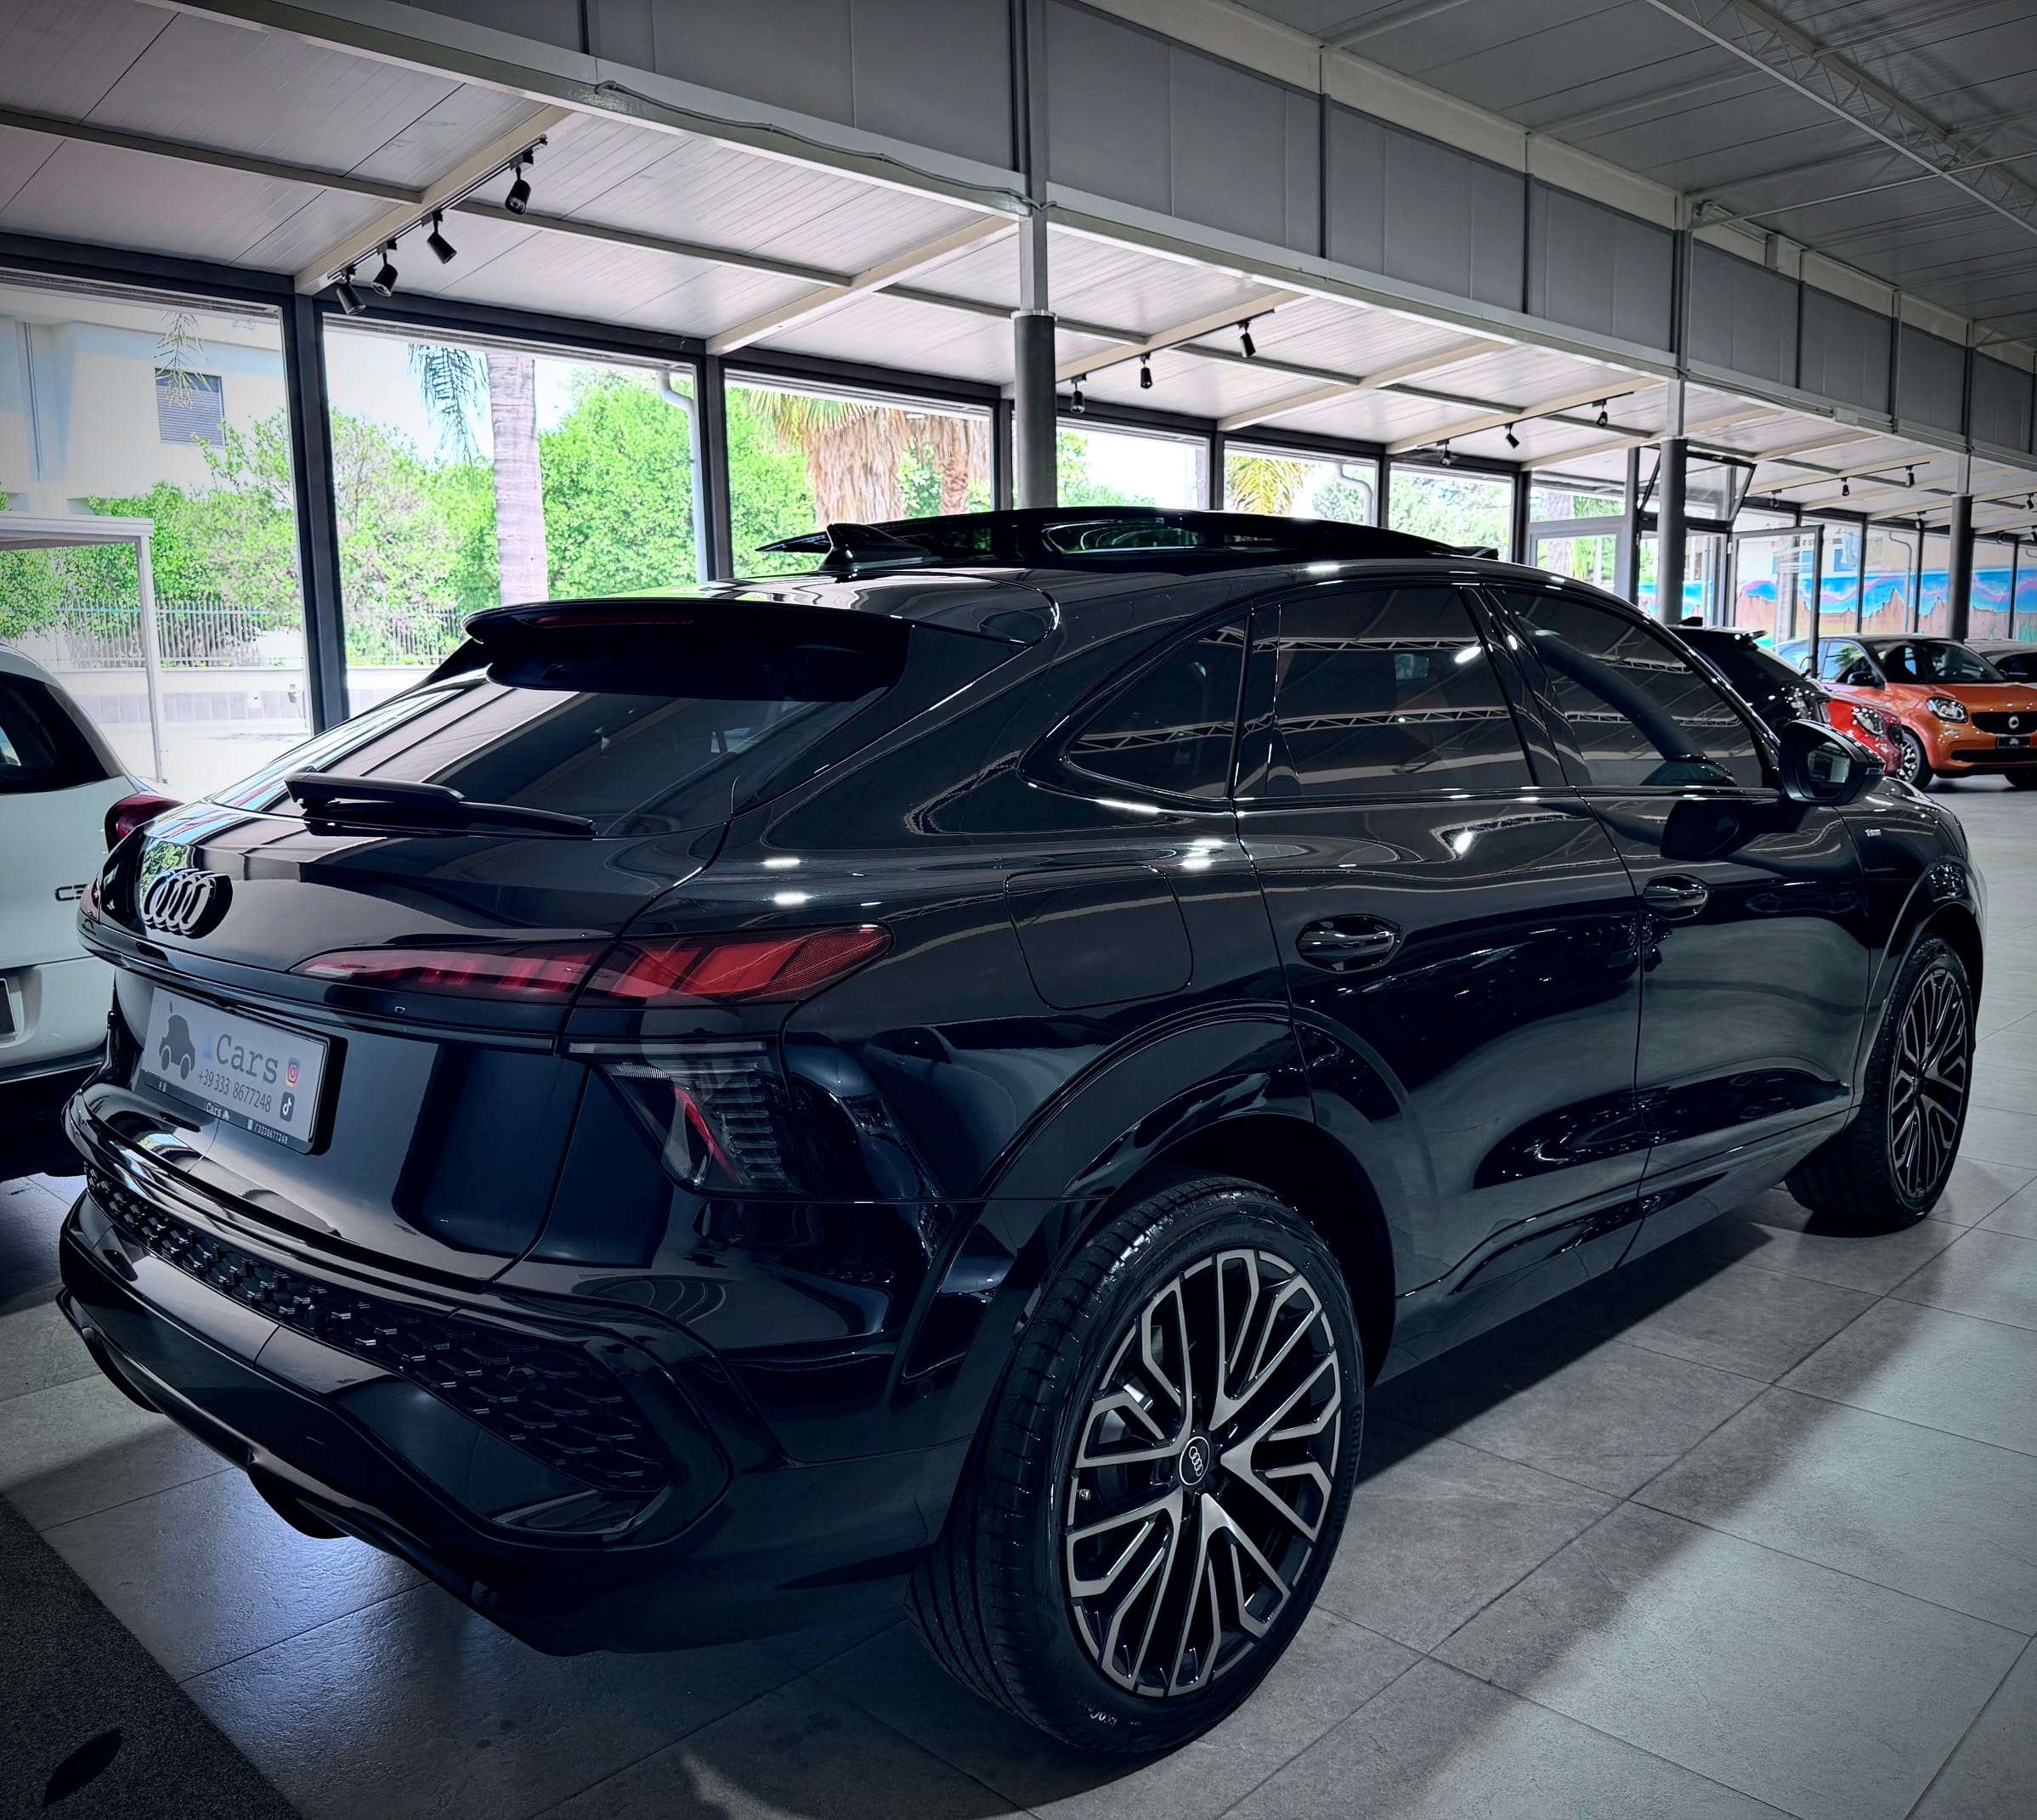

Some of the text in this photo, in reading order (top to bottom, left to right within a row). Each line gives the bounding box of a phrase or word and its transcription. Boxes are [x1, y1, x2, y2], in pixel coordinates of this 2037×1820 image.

[199, 1069, 272, 1112] +39 333 8677248
